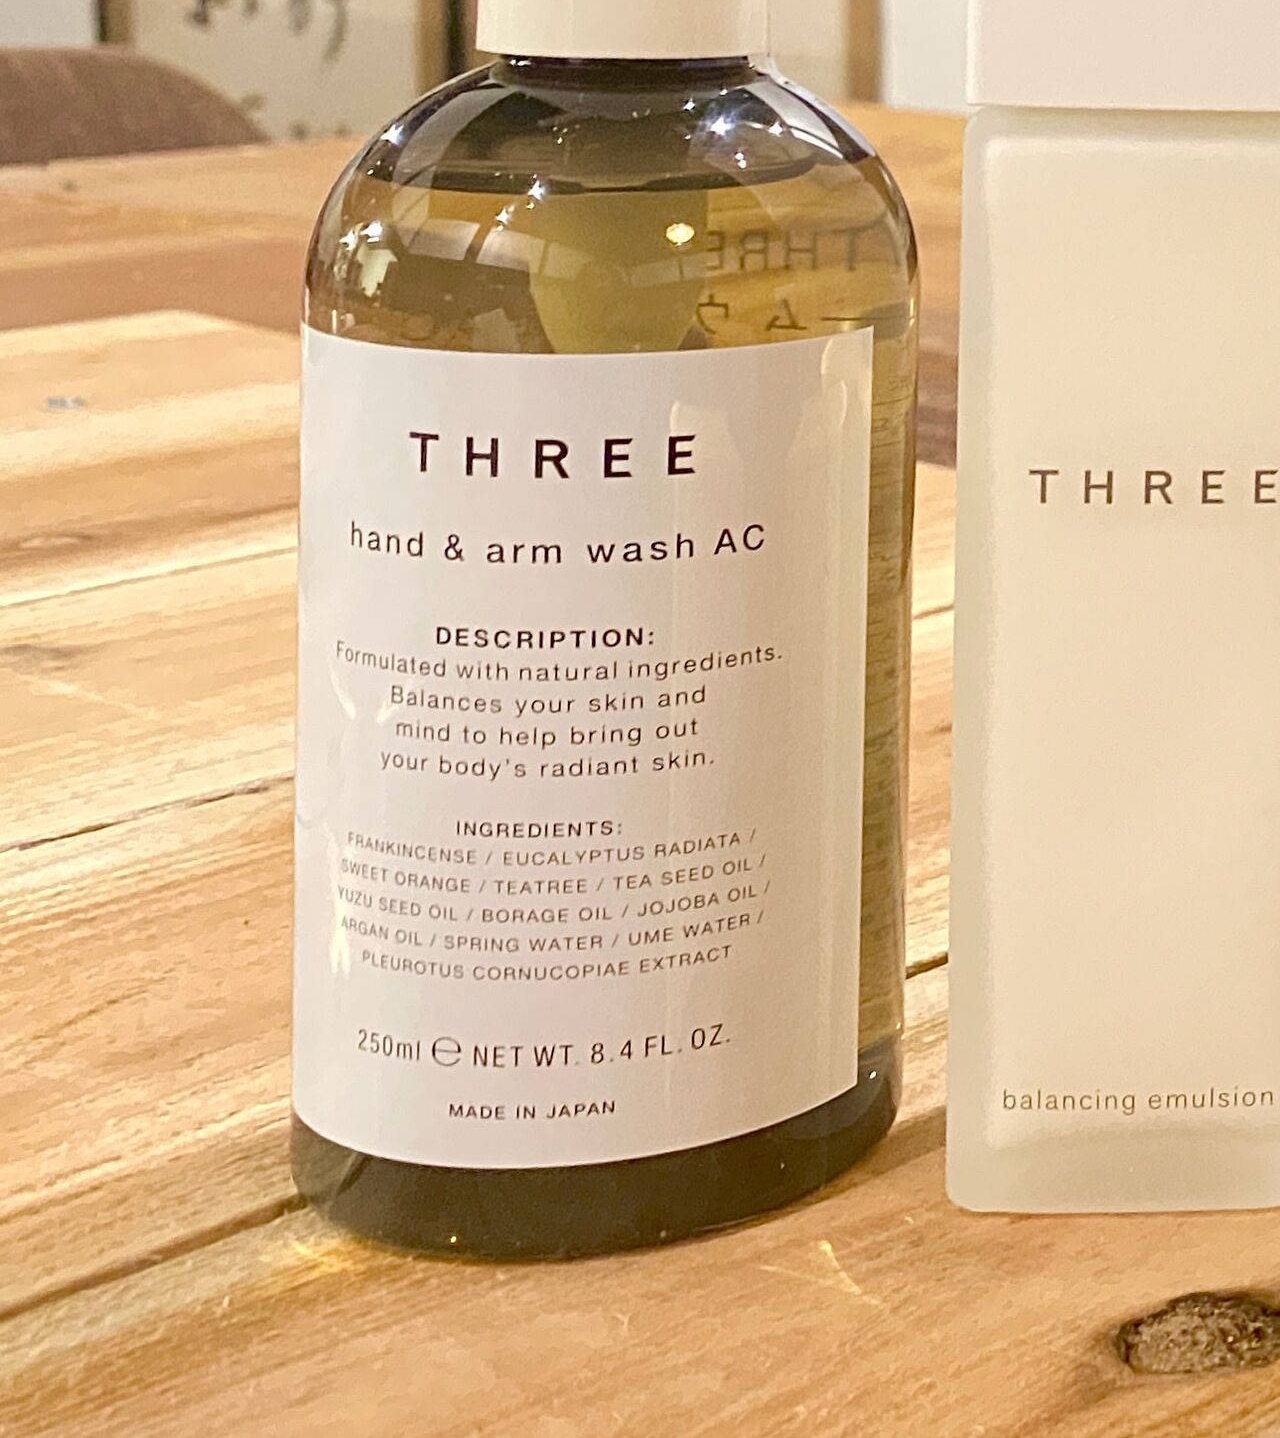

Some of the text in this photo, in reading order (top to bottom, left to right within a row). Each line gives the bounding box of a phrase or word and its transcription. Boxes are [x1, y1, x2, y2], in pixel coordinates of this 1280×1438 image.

[409, 432, 695, 479] THREE
[1029, 469, 1278, 504] THREE
[351, 521, 764, 564] hand & arm wash AC
[436, 627, 653, 649] DESCRIPTION:
[337, 640, 783, 682] Formulated with natural ingredients.
[391, 685, 705, 719] Balances your skin and
[396, 718, 698, 750] mind to help bring out
[381, 749, 714, 781] your body's radiant skin.
[457, 820, 621, 838] INGREDIENTS:
[348, 831, 477, 866] FRANKINCENSE
[503, 846, 645, 866] EUCALYPTUS
[654, 832, 740, 858] RADIATA
[341, 858, 389, 882] SWEET
[394, 871, 470, 893] ORANGE
[494, 878, 587, 896] TEATREE
[613, 874, 652, 890] TEA
[660, 865, 714, 886] SEED
[722, 858, 752, 876] OIL
[338, 885, 373, 909] YUZU
[379, 896, 422, 917] SEED
[428, 903, 458, 922] OIL
[482, 908, 569, 924] BORAGE
[578, 906, 612, 922] OIL
[637, 892, 719, 917] JOJOBA
[727, 885, 758, 903] OIL
[341, 916, 389, 940] ARGAN
[393, 928, 423, 947] OIL
[444, 935, 519, 953] SPRING
[529, 935, 603, 952] WATER
[628, 927, 673, 946] UME
[682, 913, 750, 938] WATER
[362, 944, 731, 981] PLEUROTUS CORNUCOPIAE EXTRACT
[358, 1029, 420, 1061] 250ml
[473, 1045, 523, 1068] NET
[449, 1101, 615, 1120] MADE IN JAPAN
[1003, 1086, 1273, 1116] balancing emulsion
